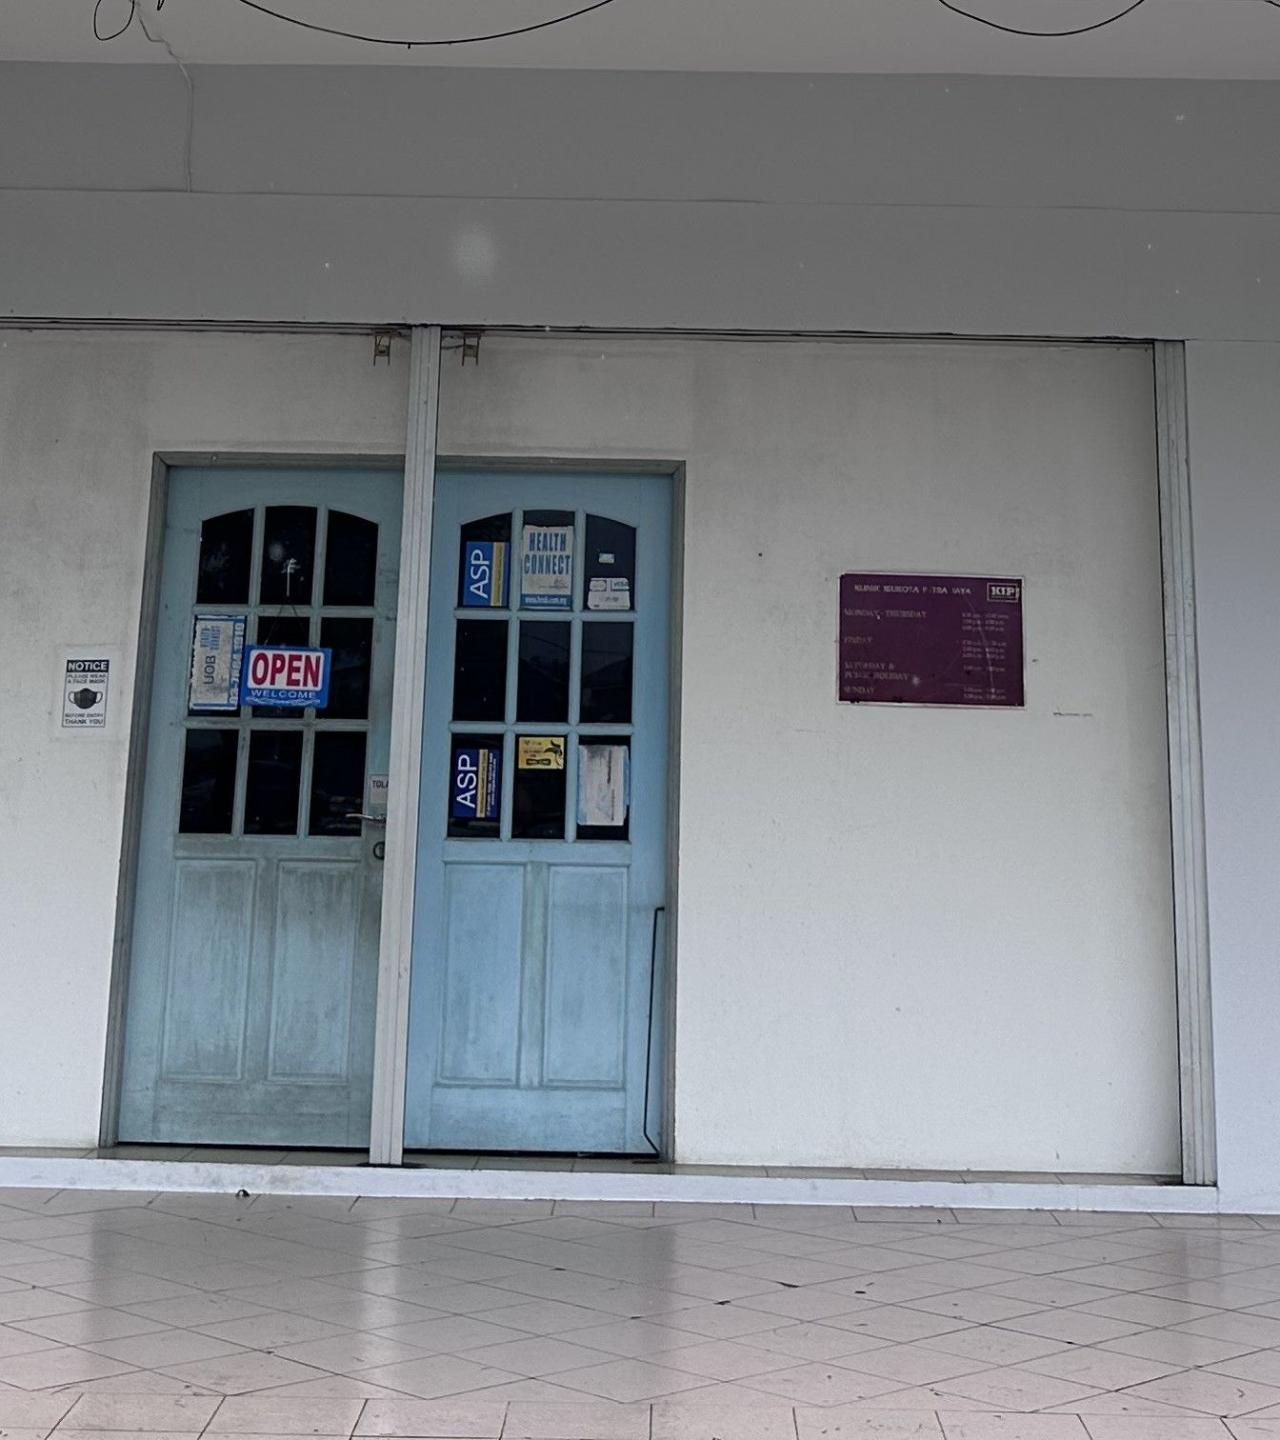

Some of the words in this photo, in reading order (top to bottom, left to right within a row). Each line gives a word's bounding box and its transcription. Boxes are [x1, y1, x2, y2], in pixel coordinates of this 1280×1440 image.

[529, 532, 566, 552] HEALTH
[470, 549, 490, 599] ASP
[523, 554, 570, 575] CONNECT
[68, 661, 107, 670] NOTICE
[203, 655, 216, 685] UOB
[251, 652, 321, 688] OPEN
[250, 689, 316, 699] WELCOME
[456, 754, 477, 809] ASP
